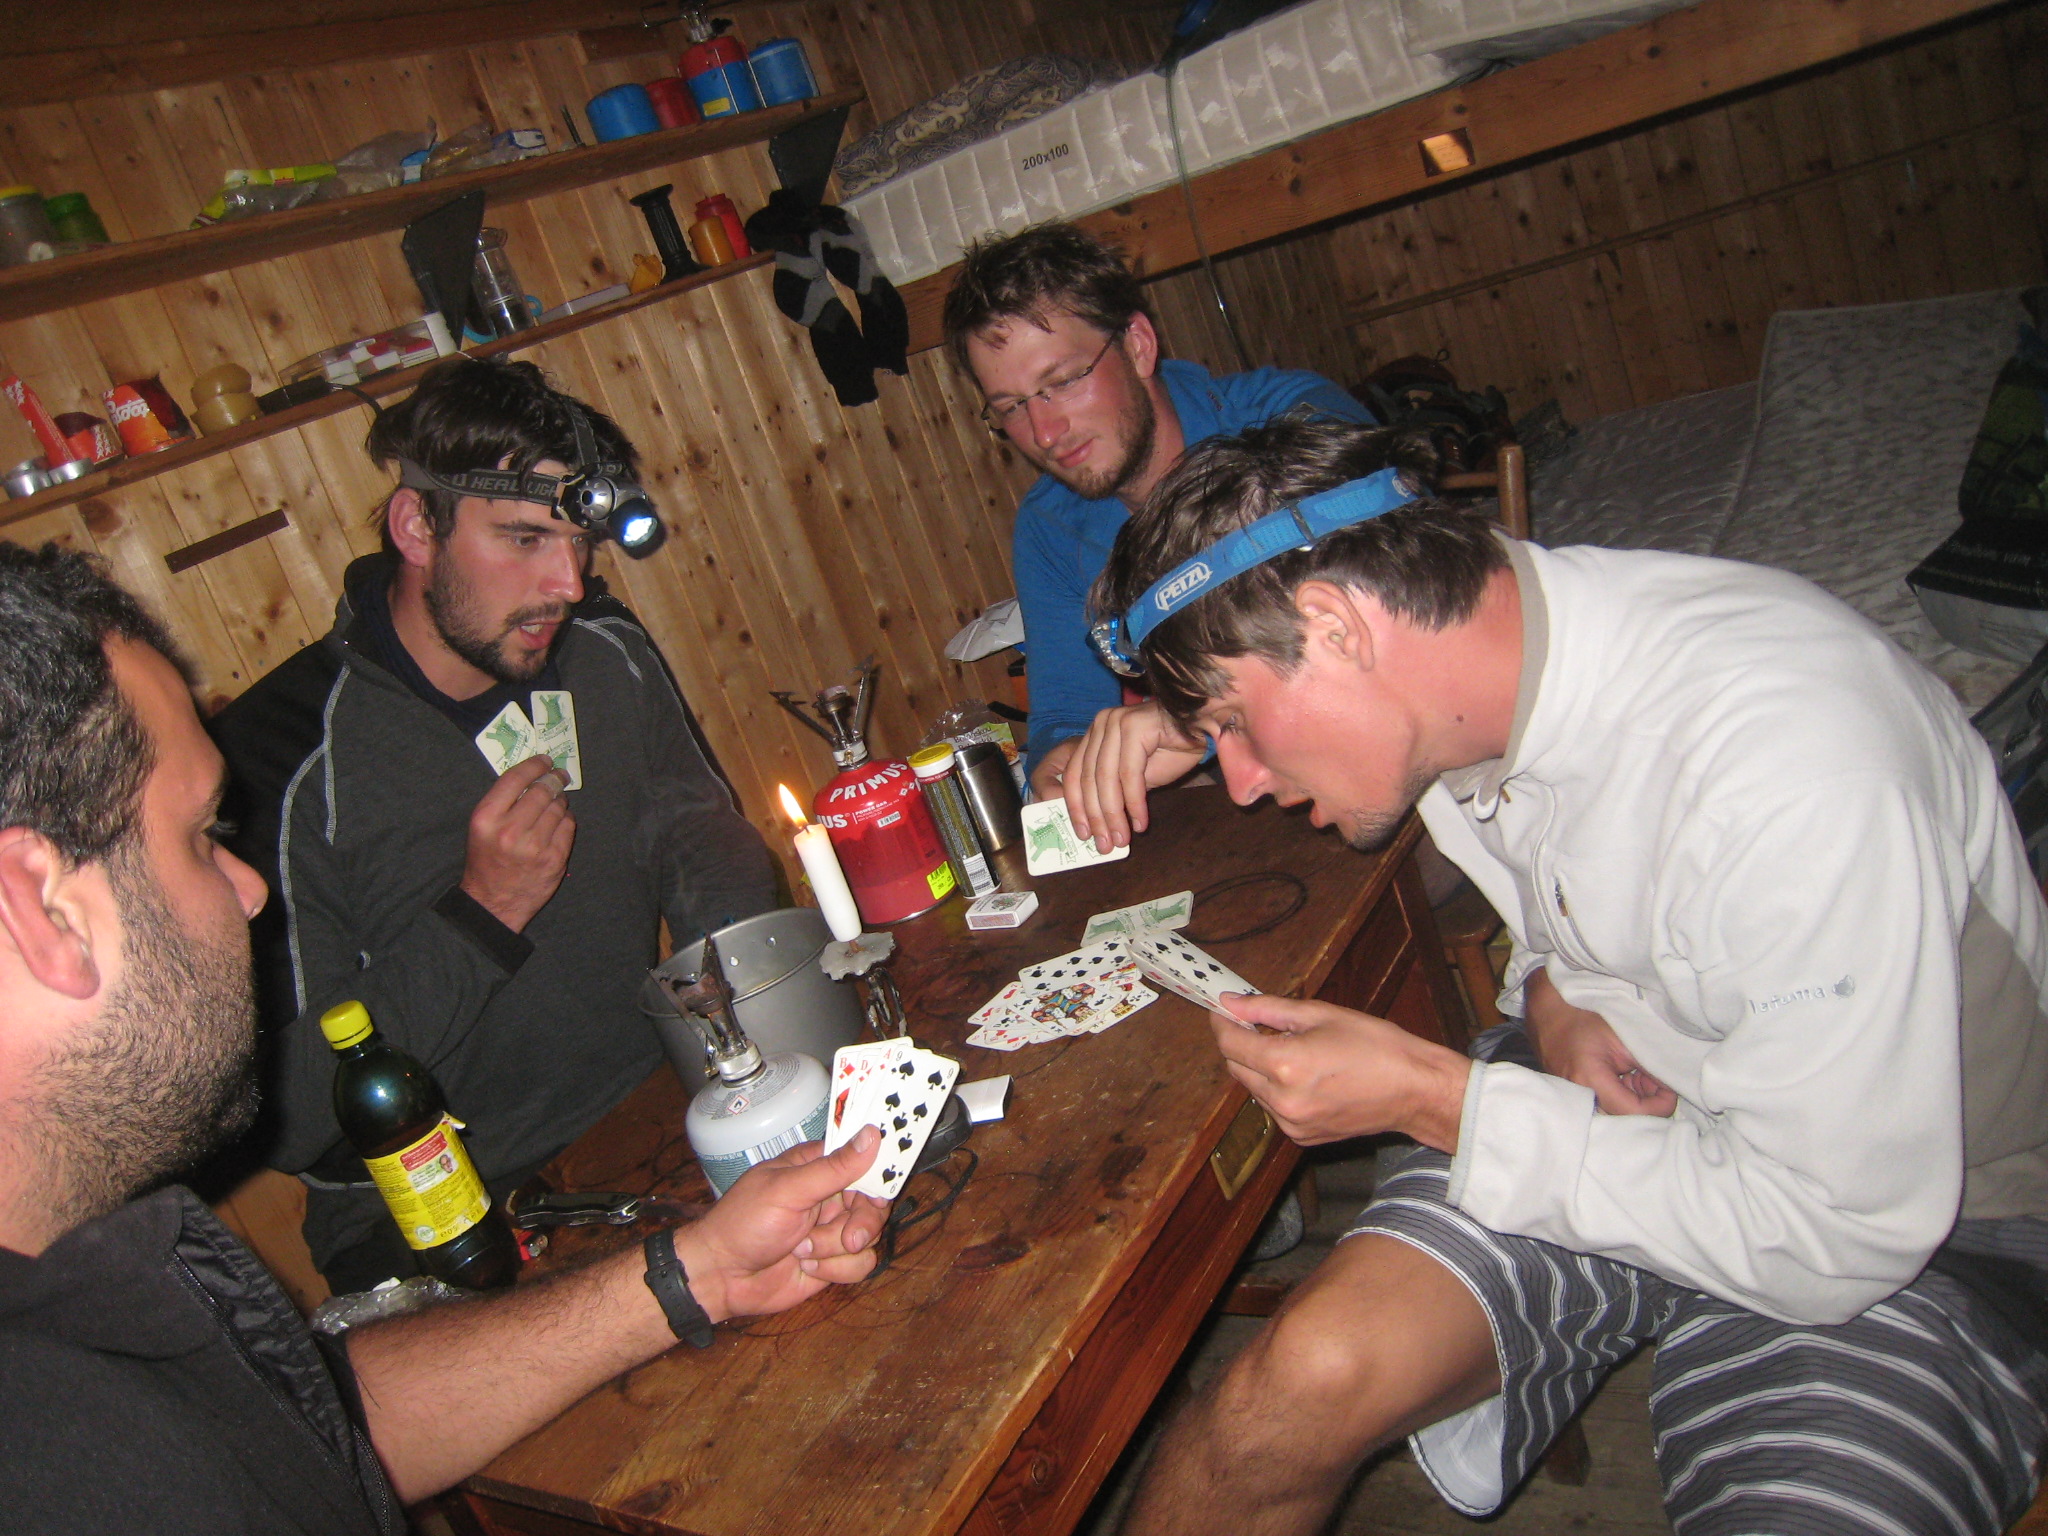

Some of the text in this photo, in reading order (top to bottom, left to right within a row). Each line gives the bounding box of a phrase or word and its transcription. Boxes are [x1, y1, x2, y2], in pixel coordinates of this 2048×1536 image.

[1022, 143, 1069, 171] 200x100
[1157, 564, 1212, 611] PETZL
[829, 763, 908, 803] PRIMUS
[1749, 987, 1826, 1014] lafuma
[883, 1048, 892, 1060] A
[896, 1051, 904, 1061] 9
[840, 1057, 848, 1069] B
[861, 1059, 869, 1071] D
[947, 1067, 955, 1079] 9
